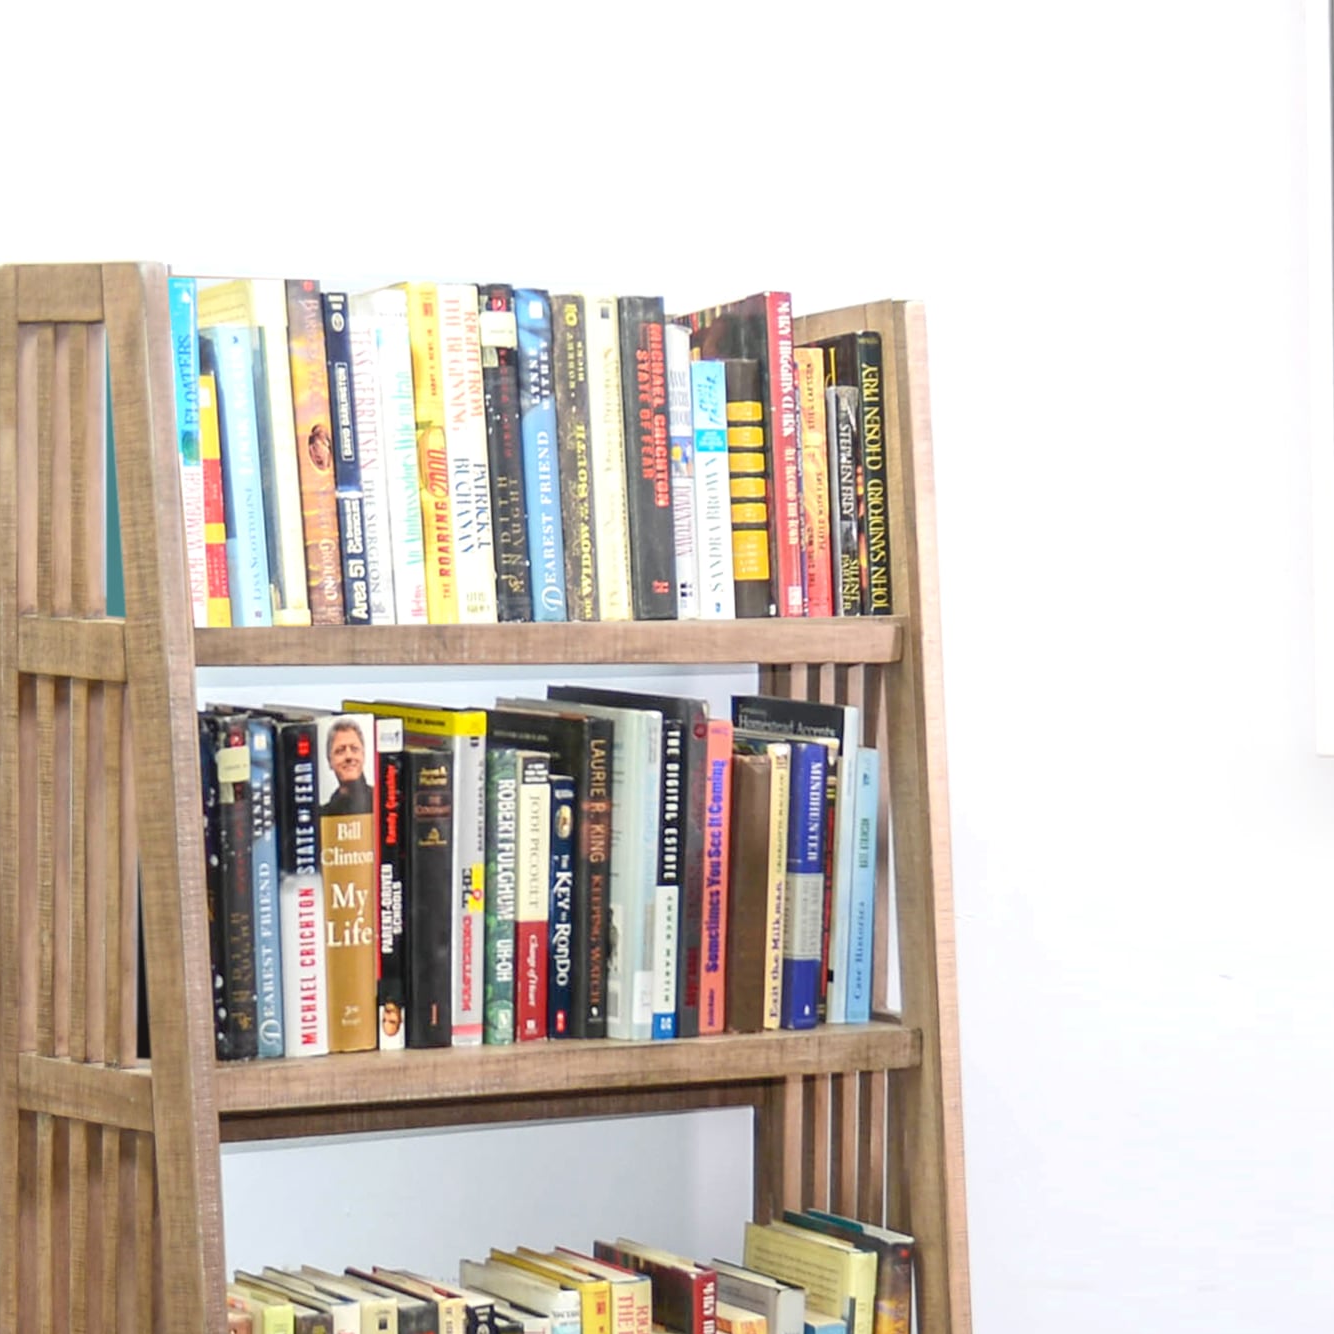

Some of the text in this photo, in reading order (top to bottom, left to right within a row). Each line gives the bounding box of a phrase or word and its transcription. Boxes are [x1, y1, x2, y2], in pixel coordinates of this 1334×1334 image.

[178, 334, 199, 426] FLOATERS
[338, 367, 353, 457] DAVID DARLINGTON
[352, 329, 380, 472] TESS GERRITSEN
[528, 345, 542, 405] LYNNE
[636, 349, 655, 480] STATE OF FEAR
[777, 301, 796, 438] MARY HIGGINS CLARK
[649, 323, 670, 508] MICHAEL CRICHTON
[861, 362, 883, 470] CHOSEN PREY
[453, 457, 475, 554] BUCHANAN
[473, 463, 490, 529] PATRICK
[701, 457, 722, 520] BROWN
[839, 423, 855, 518] STEPHEN FREY
[184, 472, 205, 607] JOSEPH WAMBAUGH
[365, 513, 383, 593] SURGEON
[434, 500, 452, 577] ROARING
[536, 430, 565, 612] DEAREST FRIEND
[579, 522, 593, 597] WIDOW
[673, 485, 693, 557] DOWNTOWN
[705, 525, 725, 593] SANDRA
[867, 478, 889, 612] JOHN SANDFORD
[320, 538, 338, 602] GROUND
[347, 558, 369, 620] Area 51
[841, 553, 852, 611] PARTNER
[849, 558, 860, 602] SILENT
[252, 777, 262, 837] LYNNE
[294, 762, 316, 875] STATE FEAR
[337, 821, 361, 840] Bill
[528, 795, 541, 835] JODI
[589, 739, 607, 864] LAURIE R. KING
[662, 729, 681, 880] THE DIGITAL ESTATE
[806, 761, 823, 862] MINDHUNTER
[321, 847, 375, 867] Clinton
[496, 779, 516, 920] ROBERT FULGHUM
[528, 837, 541, 909] PICOULT
[553, 870, 573, 910] KEY
[704, 759, 728, 974] Sometimes You See It Coming
[327, 916, 373, 948] Life
[331, 881, 369, 916] My
[380, 863, 394, 954] PARENT-DRIVEN
[392, 880, 403, 935] SCHOOLS
[589, 873, 602, 1006] KEEPING WATCH
[257, 862, 282, 1046] DEAREST FRIEND
[298, 887, 318, 1046] MICHAEL CRICHTON
[496, 938, 514, 982] UH-OH
[769, 880, 783, 1018] Exit the Milkman
[853, 901, 866, 1000] Case Histories
[617, 1292, 635, 1329] THE
